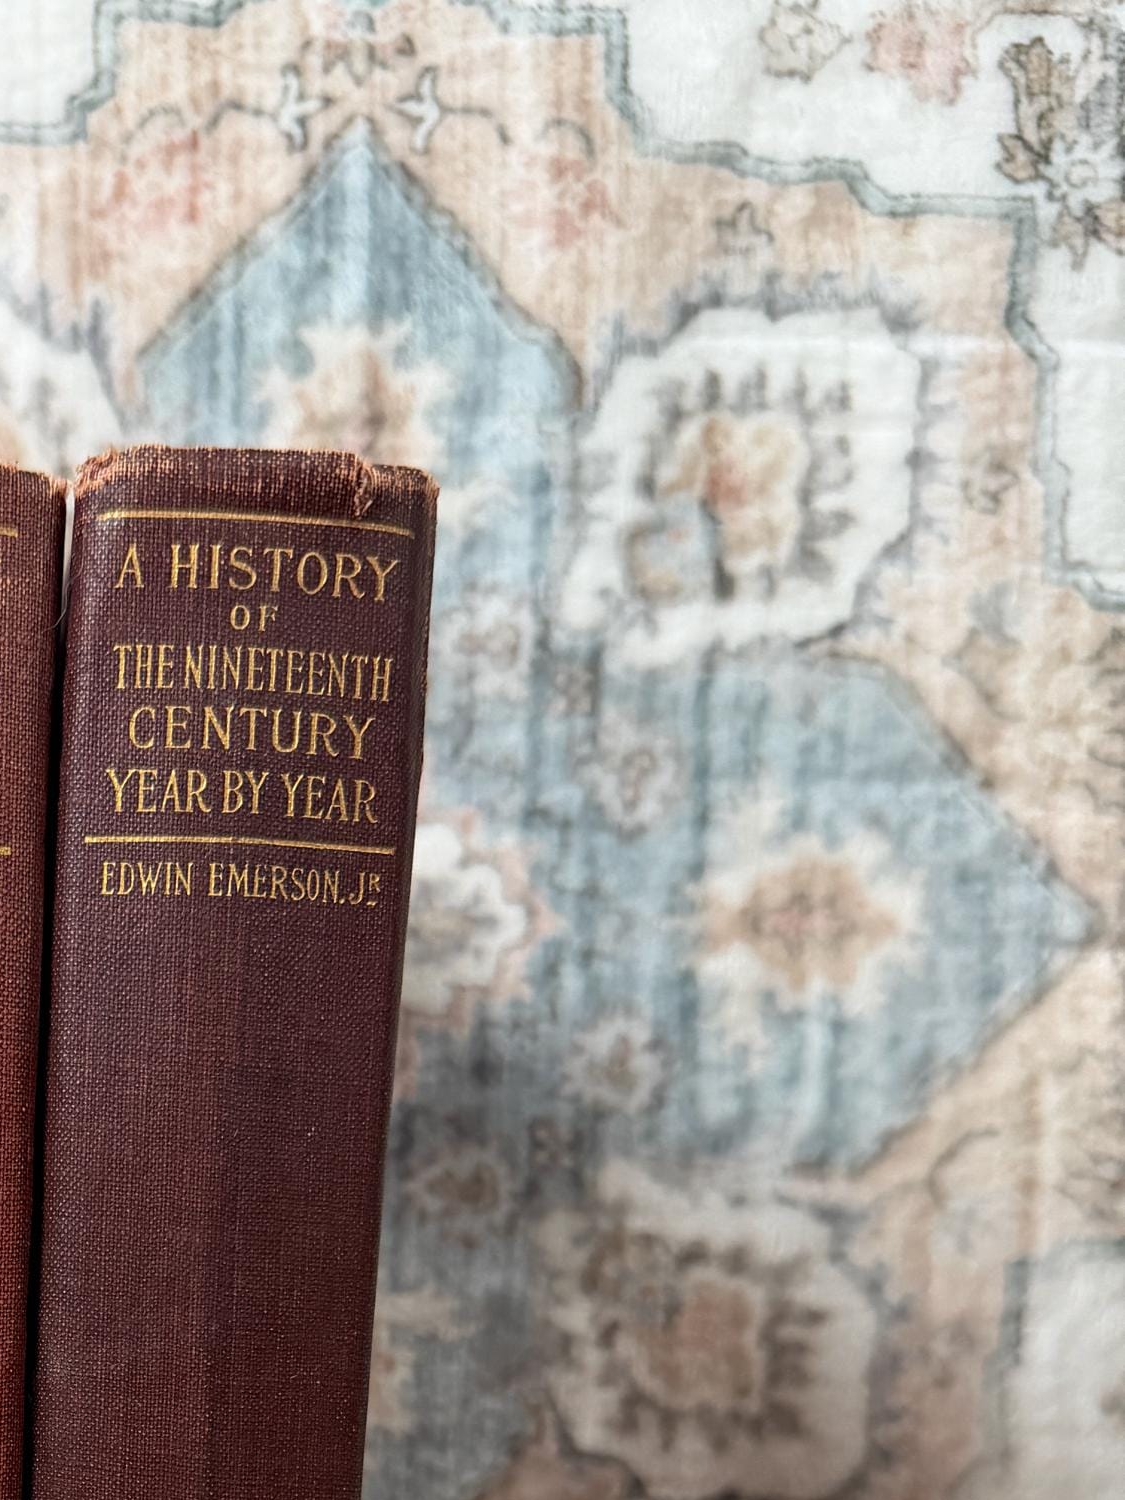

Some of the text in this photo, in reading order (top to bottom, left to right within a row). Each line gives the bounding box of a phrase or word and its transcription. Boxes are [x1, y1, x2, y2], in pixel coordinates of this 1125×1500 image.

[113, 542, 401, 602] A HISTORY
[229, 604, 279, 633] OF
[112, 643, 394, 702] THE NINETEENTH
[128, 705, 378, 761] CENTURY
[105, 767, 379, 825] YEAR BY YEAR
[100, 860, 194, 898] EDWIN
